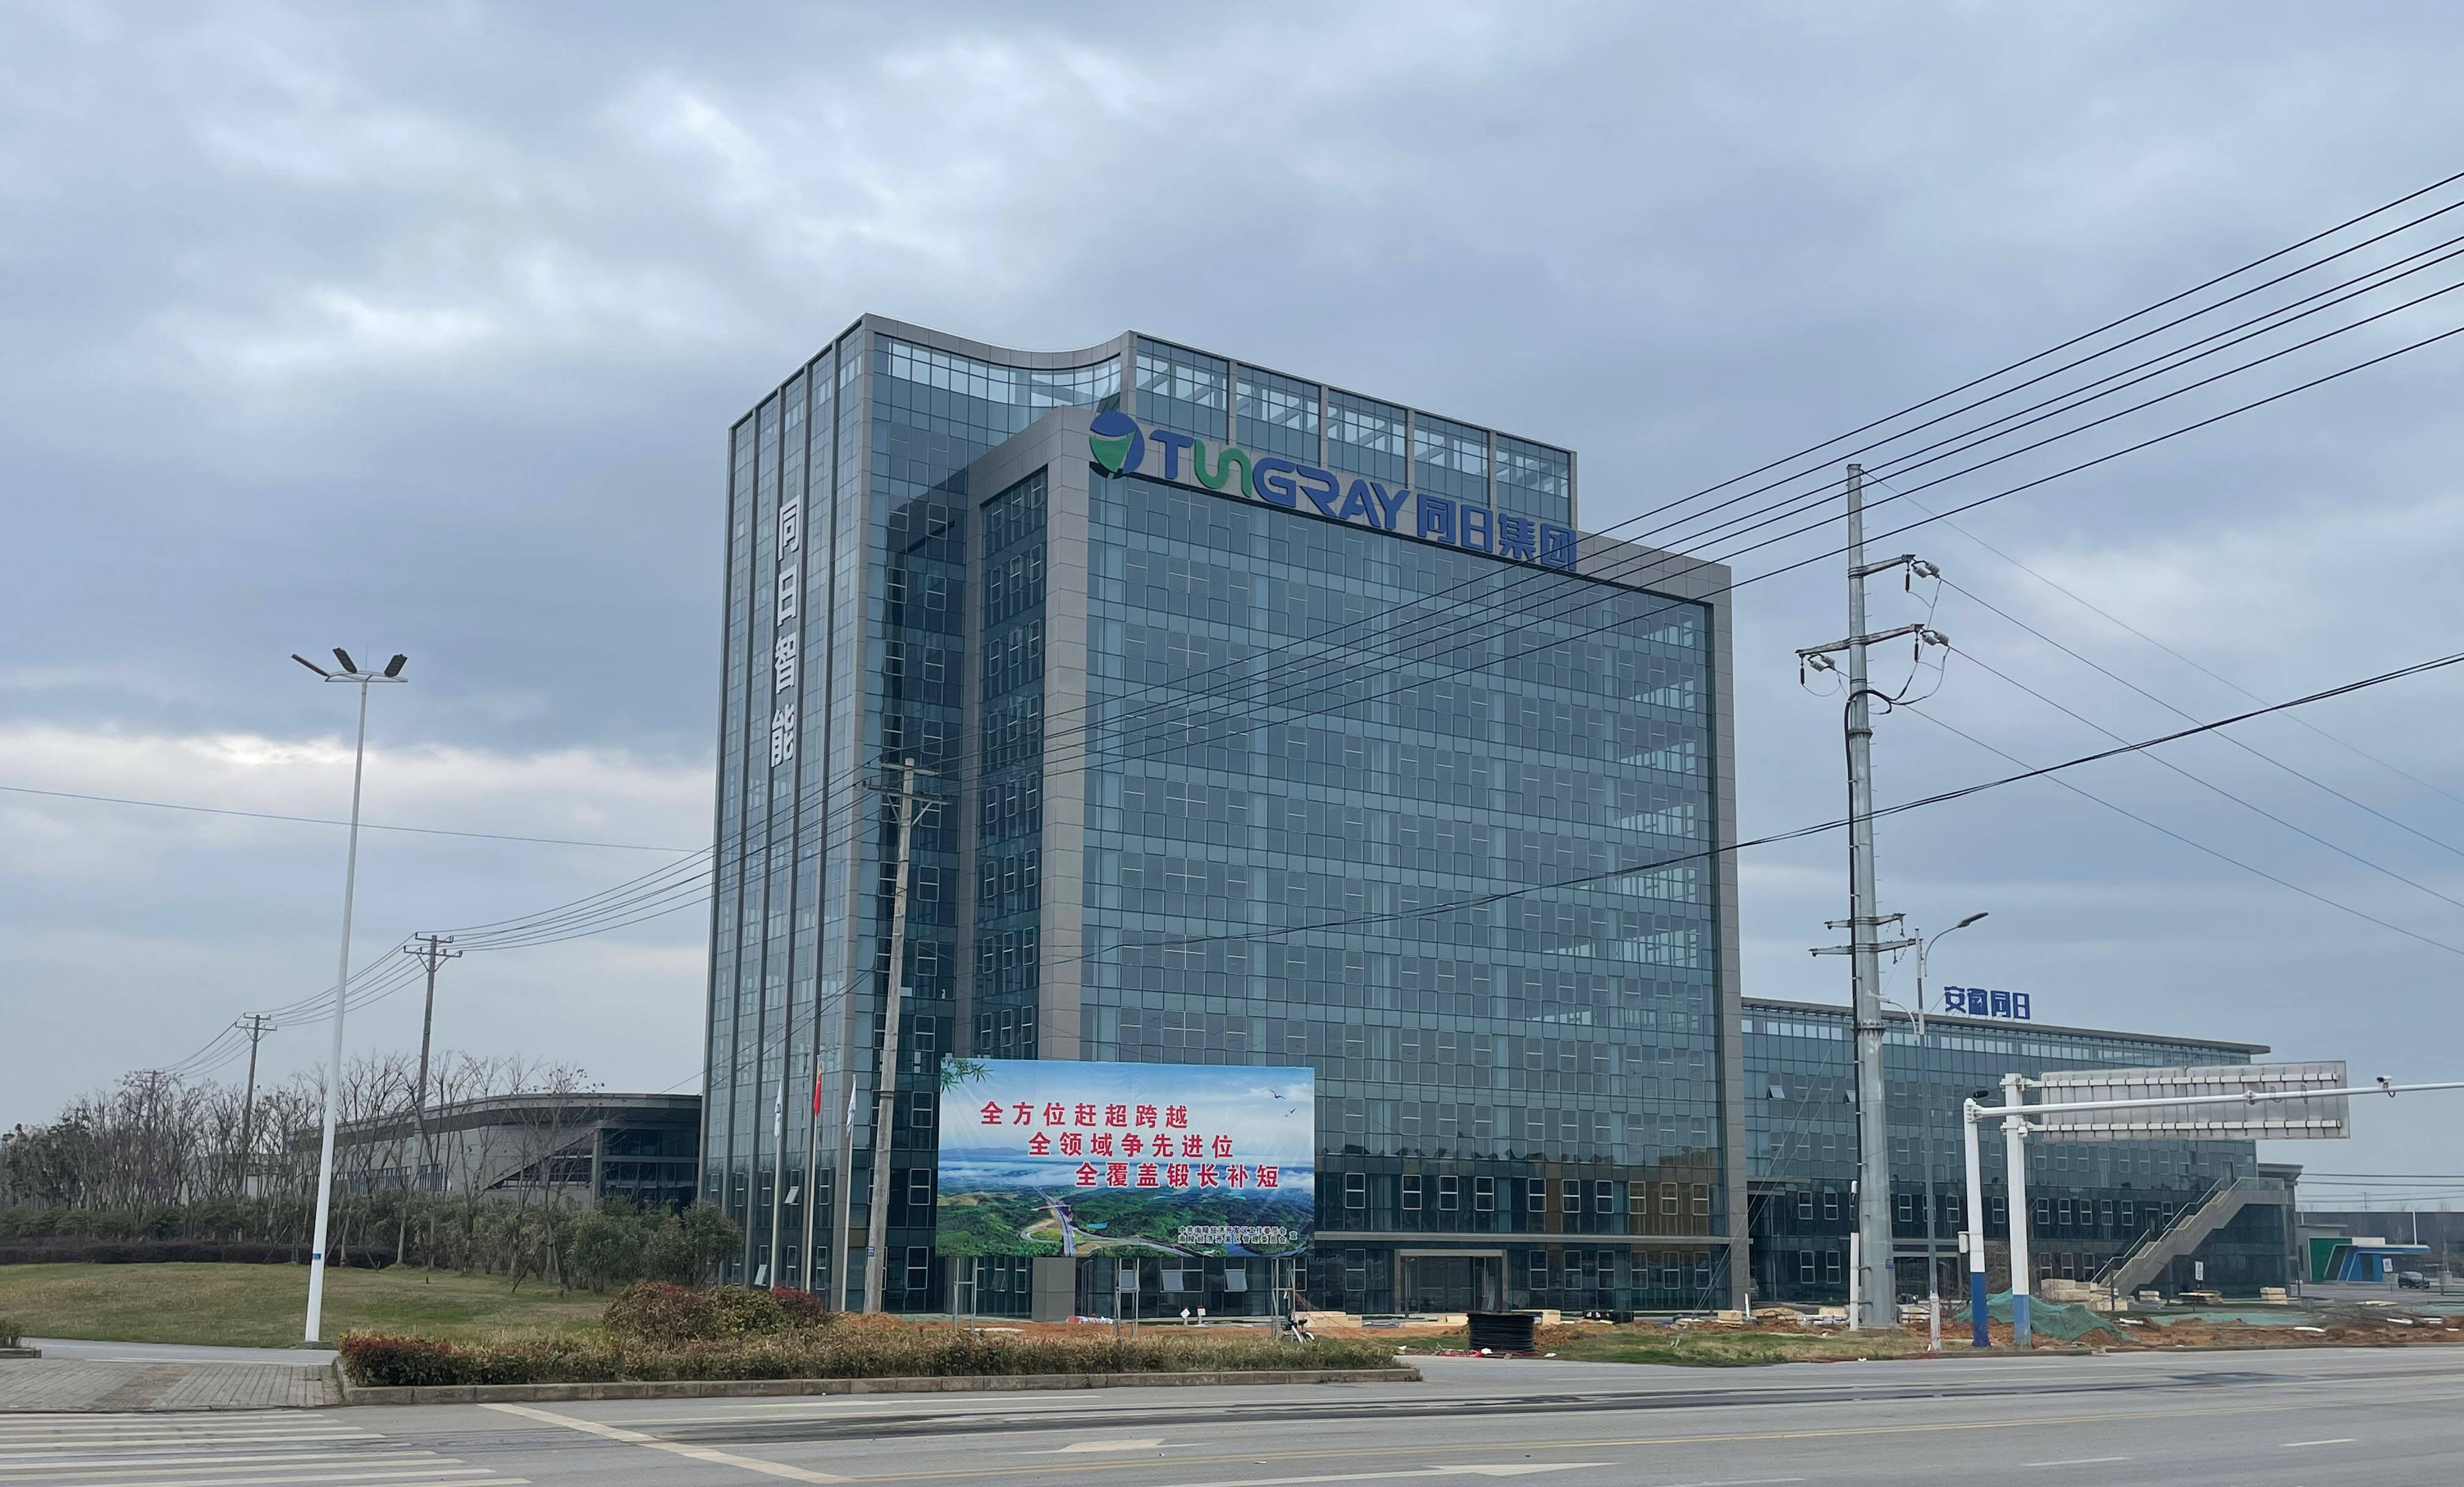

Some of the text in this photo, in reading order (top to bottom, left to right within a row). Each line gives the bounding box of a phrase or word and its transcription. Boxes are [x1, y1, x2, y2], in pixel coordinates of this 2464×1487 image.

[1150, 429, 1577, 572] TUNGRAY 同日集团
[771, 494, 800, 767] 同日智能
[980, 1100, 1188, 1129] 全方位赶超跨越
[1028, 1131, 1234, 1158] 全领域争先进位
[1076, 1161, 1278, 1188] 全覆盖锻长补短
